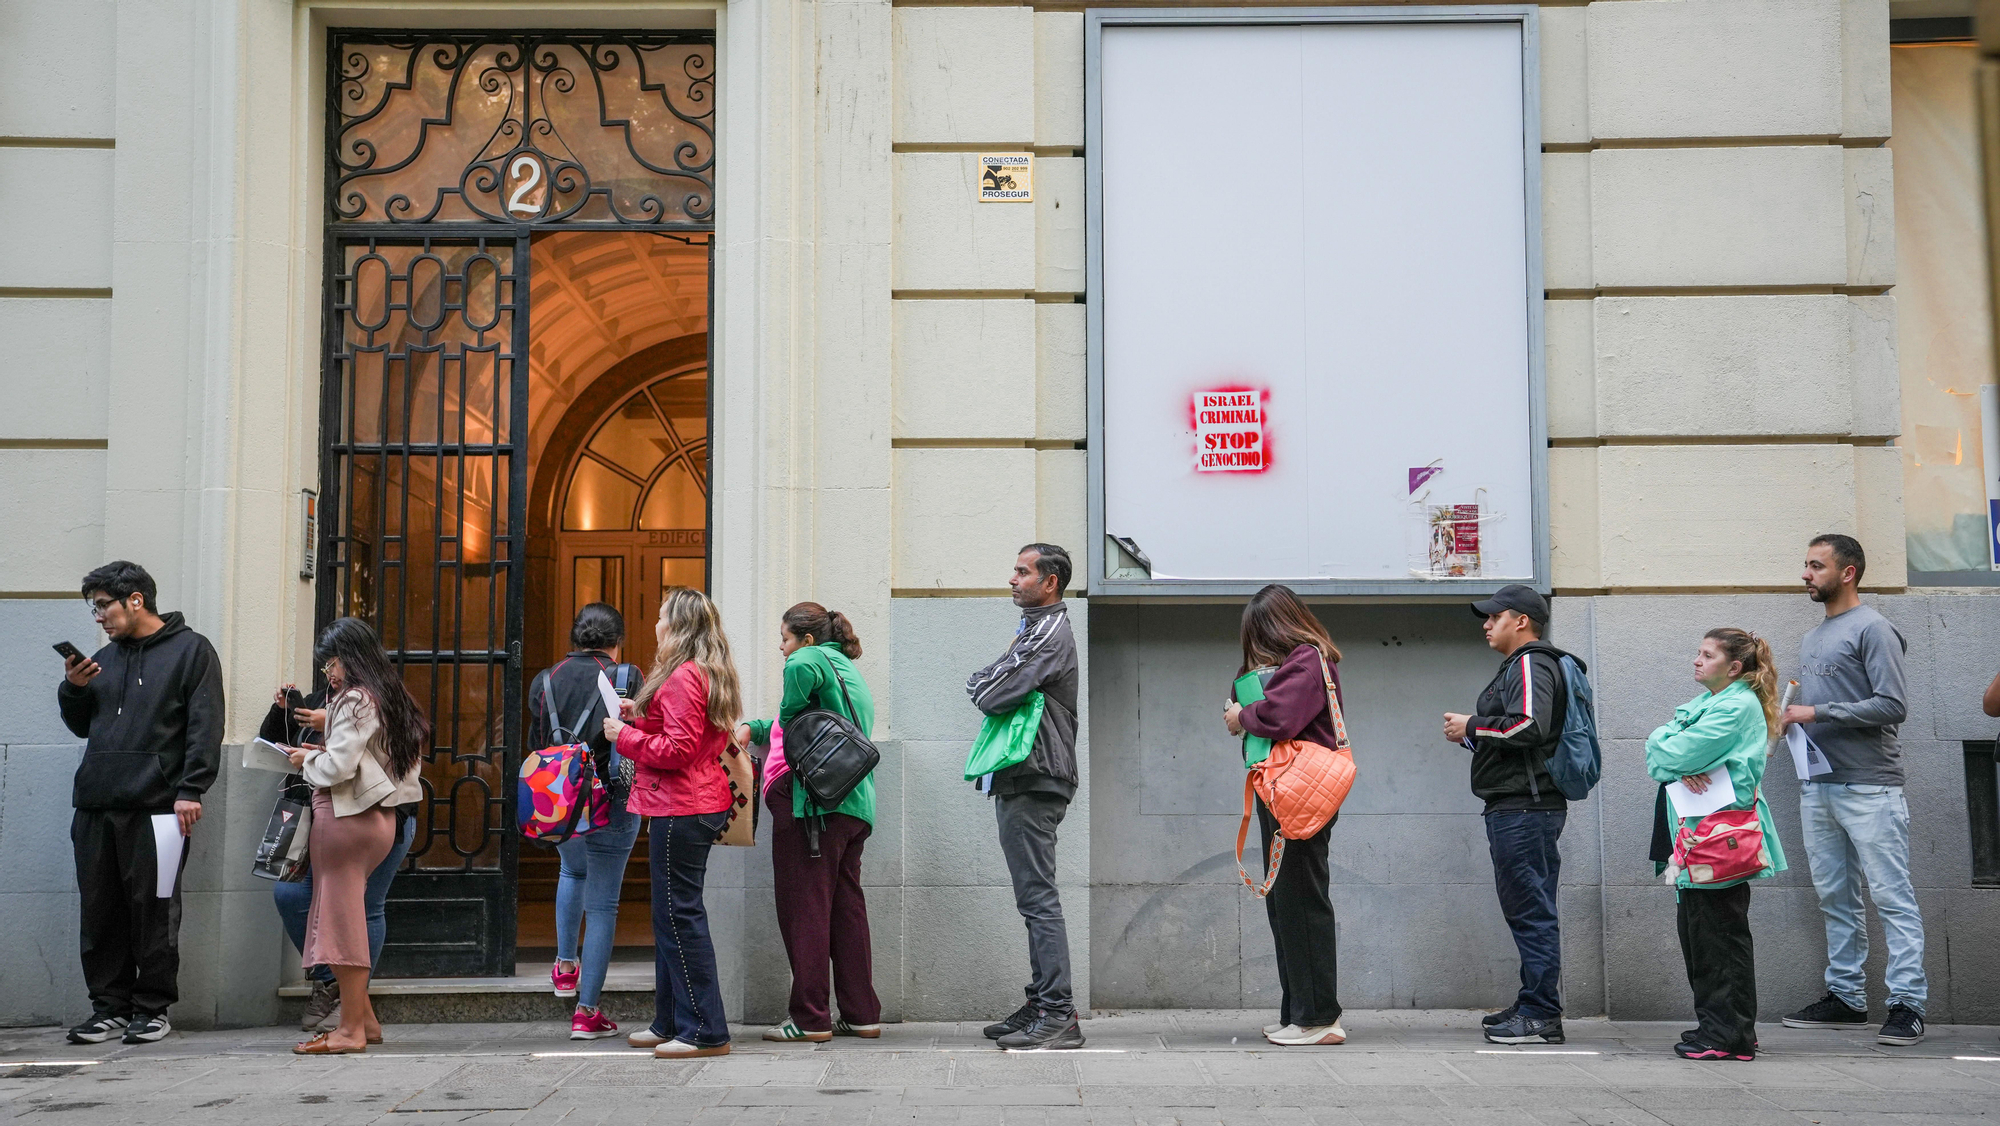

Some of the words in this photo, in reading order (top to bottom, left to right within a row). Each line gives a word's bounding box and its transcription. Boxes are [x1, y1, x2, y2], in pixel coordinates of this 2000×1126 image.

[508, 156, 541, 213] 2
[1203, 394, 1255, 407] ISRAEL
[1200, 409, 1259, 424] CRIMINAL
[1204, 431, 1260, 450] STOP
[1201, 451, 1261, 468] GENOCIDIO
[649, 531, 706, 544] EDIFICI
[1800, 663, 1838, 676] ONCLER
